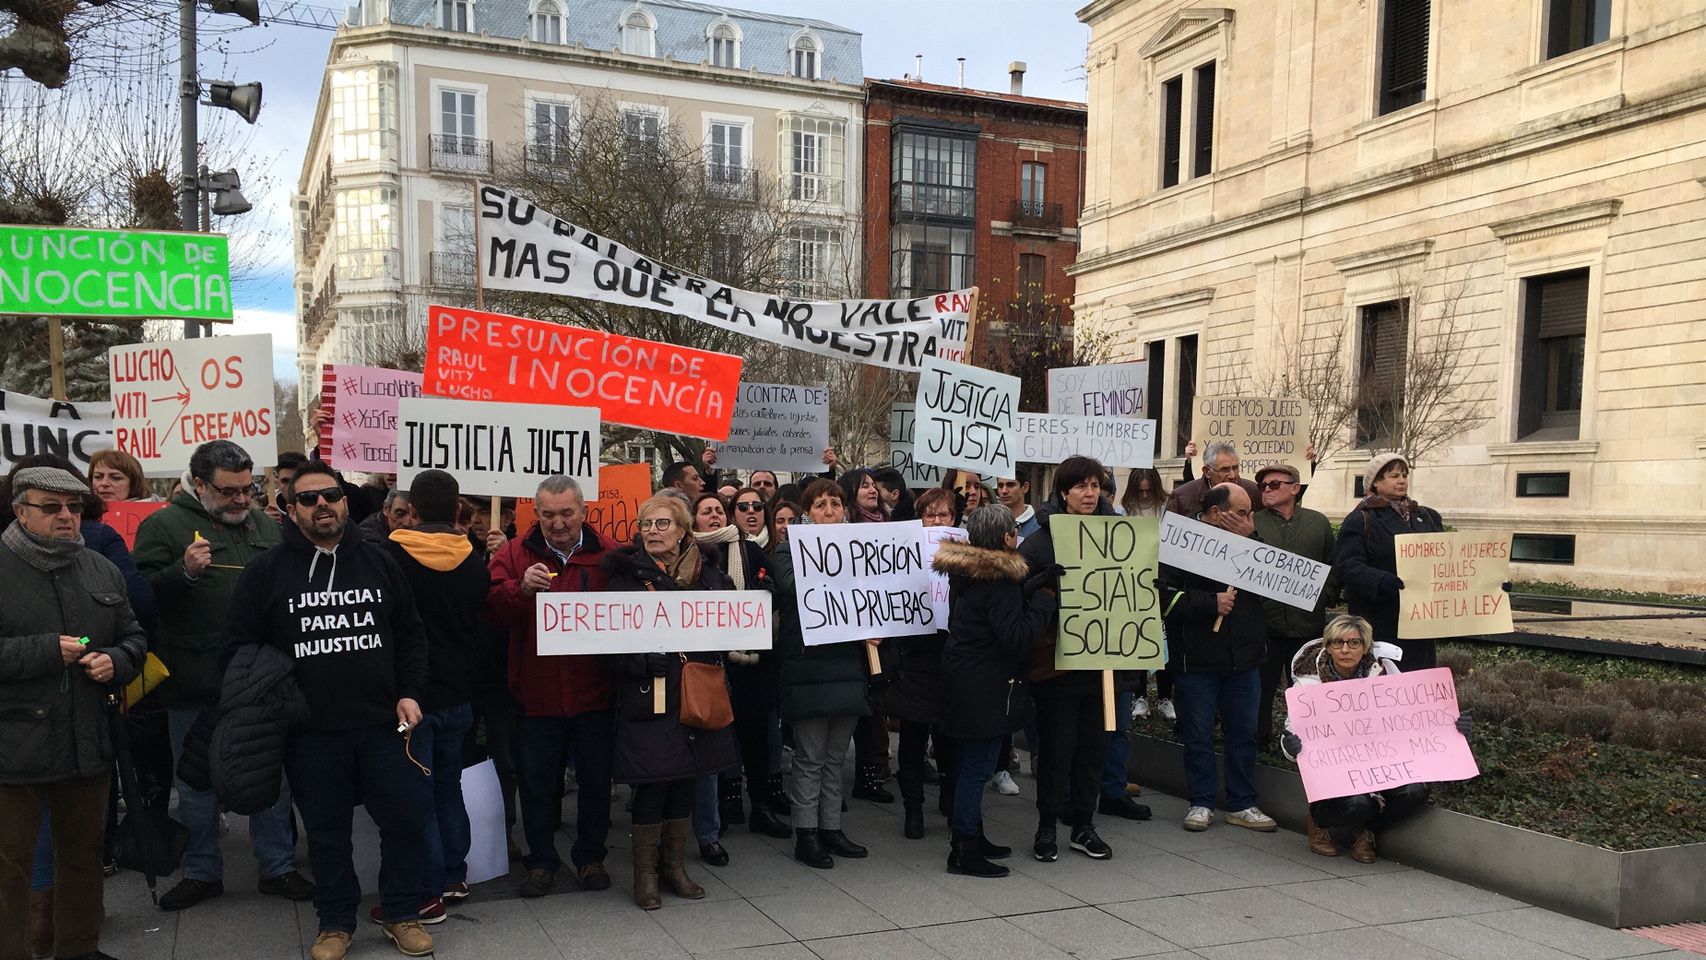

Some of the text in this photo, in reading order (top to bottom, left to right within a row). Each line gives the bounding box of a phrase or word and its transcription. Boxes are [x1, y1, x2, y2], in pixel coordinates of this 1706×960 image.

[0, 234, 218, 265] UNCIÓN DE
[481, 186, 536, 225] SU
[763, 298, 814, 327] NO
[841, 297, 931, 328] VALE
[489, 236, 572, 284] MAS
[593, 260, 674, 307] QUE
[438, 312, 705, 378] PRESUNCIÓN DE
[438, 346, 486, 371] RAUL
[113, 348, 174, 382] LUCHO
[201, 355, 243, 390] OS
[438, 366, 474, 382] VITY
[436, 381, 493, 400] LUCHO
[508, 355, 723, 419] INOCENCIA
[746, 386, 797, 404] CONTRA
[805, 389, 827, 405] DE:
[1056, 369, 1136, 393] SOY IGUAL
[115, 392, 147, 419] VITI
[924, 368, 1011, 428] JUSTICIA
[1058, 388, 1144, 416] DE FEMINISTA
[1200, 399, 1303, 417] QUEREMOS JUECES
[117, 419, 161, 458] RAÚL
[181, 407, 271, 445] CREEMOS
[1086, 420, 1150, 441] HOMBRES
[1209, 420, 1296, 437] QUE JUZGUEN
[403, 421, 592, 477] JUSTICIA JUSTA
[766, 444, 777, 454] de
[780, 443, 788, 454] la
[790, 445, 814, 457] prensa
[928, 417, 1010, 468] JUSTA
[1243, 440, 1295, 455] SOCIEDAD
[1079, 520, 1136, 562] NO
[1161, 523, 1228, 561] JUSTICIA
[1400, 541, 1507, 560] HOMBRES Y MUJERES
[798, 536, 922, 578] NO PRISIÓN
[1253, 546, 1322, 581] COBARDE
[1433, 560, 1477, 578] IGUALES
[1239, 566, 1321, 601] MANIPULADA
[1430, 580, 1468, 592] TAMBIEN
[301, 611, 375, 632] PARA LA
[543, 601, 766, 632] DERECHO A DEFENSA
[804, 584, 849, 630] SIN
[852, 588, 934, 627] PRUEBAS
[1410, 594, 1502, 621] ANTE LA LEY
[294, 633, 382, 658] INJUSTICIA
[1063, 614, 1160, 659] SOLOS
[1325, 690, 1369, 713] SOLO
[1371, 681, 1454, 709] ESCUCHAN
[1305, 724, 1337, 741] UNA
[1381, 707, 1457, 732] NOSOTROS
[1307, 732, 1447, 770] GRITAREMOS MÁS
[1348, 760, 1422, 790] FUERTE
